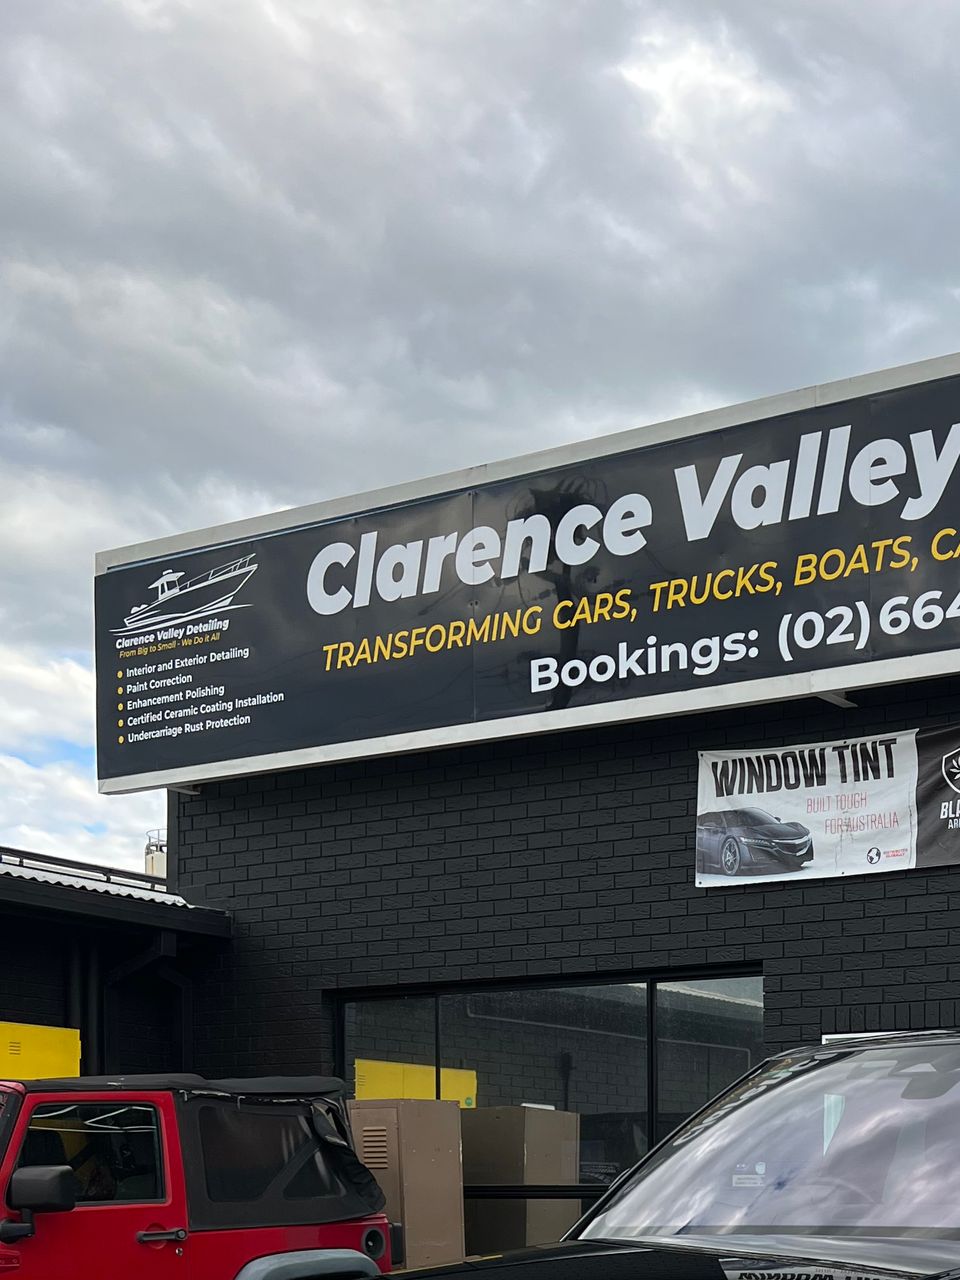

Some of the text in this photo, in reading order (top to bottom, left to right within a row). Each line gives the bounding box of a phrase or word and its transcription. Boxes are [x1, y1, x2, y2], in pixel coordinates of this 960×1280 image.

[306, 492, 653, 615] Clarence
[322, 604, 543, 672] TRANSFORMING
[552, 588, 639, 630] CARS,
[648, 561, 784, 612] TRUCKS,
[793, 534, 919, 587] BOATS,
[115, 618, 230, 649] Clarence Valley Detailing
[119, 650, 137, 659] From
[137, 646, 149, 657] Big
[149, 644, 157, 653] to
[157, 641, 177, 652] Small
[181, 638, 193, 648] We
[193, 635, 204, 645] Do
[529, 628, 760, 694] Bookings:
[777, 600, 871, 662] (02)
[126, 647, 250, 678] Interior and Exterior Detailing
[126, 673, 193, 695] Paint Correction
[127, 684, 225, 711] Enhancement Polishing
[127, 691, 285, 727] Certified Ceramic Coating Installation
[127, 714, 251, 743] Undercarriage Rust Protection
[711, 738, 898, 798] WINDOW TINT
[806, 791, 868, 814] BUILT TOUGH
[824, 811, 900, 835] FOR AUSTRALIA
